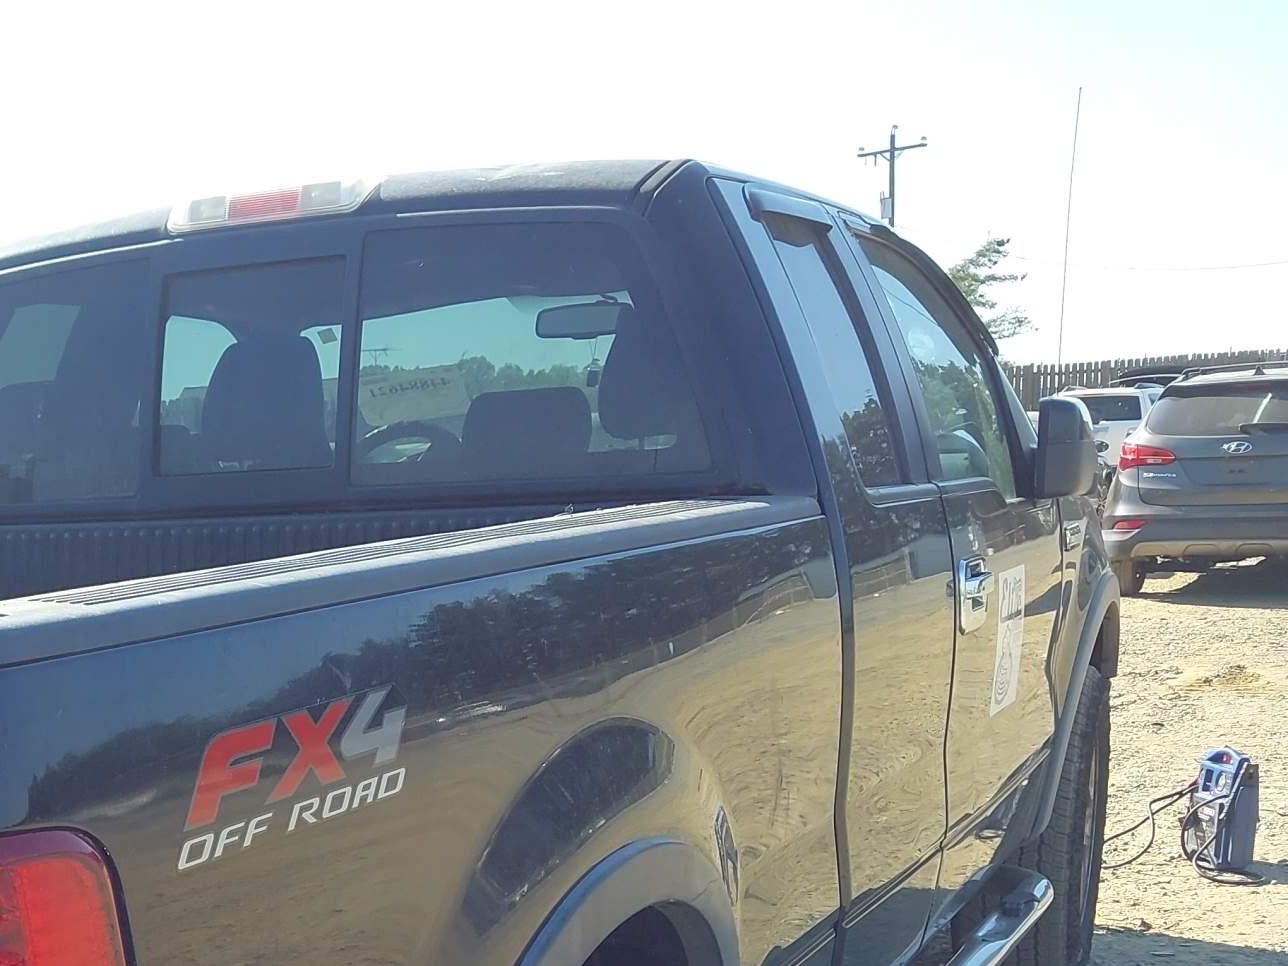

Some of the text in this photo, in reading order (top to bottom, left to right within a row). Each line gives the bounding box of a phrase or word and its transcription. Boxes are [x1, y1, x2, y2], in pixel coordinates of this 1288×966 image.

[177, 767, 406, 871] OFF ROAD
[184, 685, 408, 832] FX4
